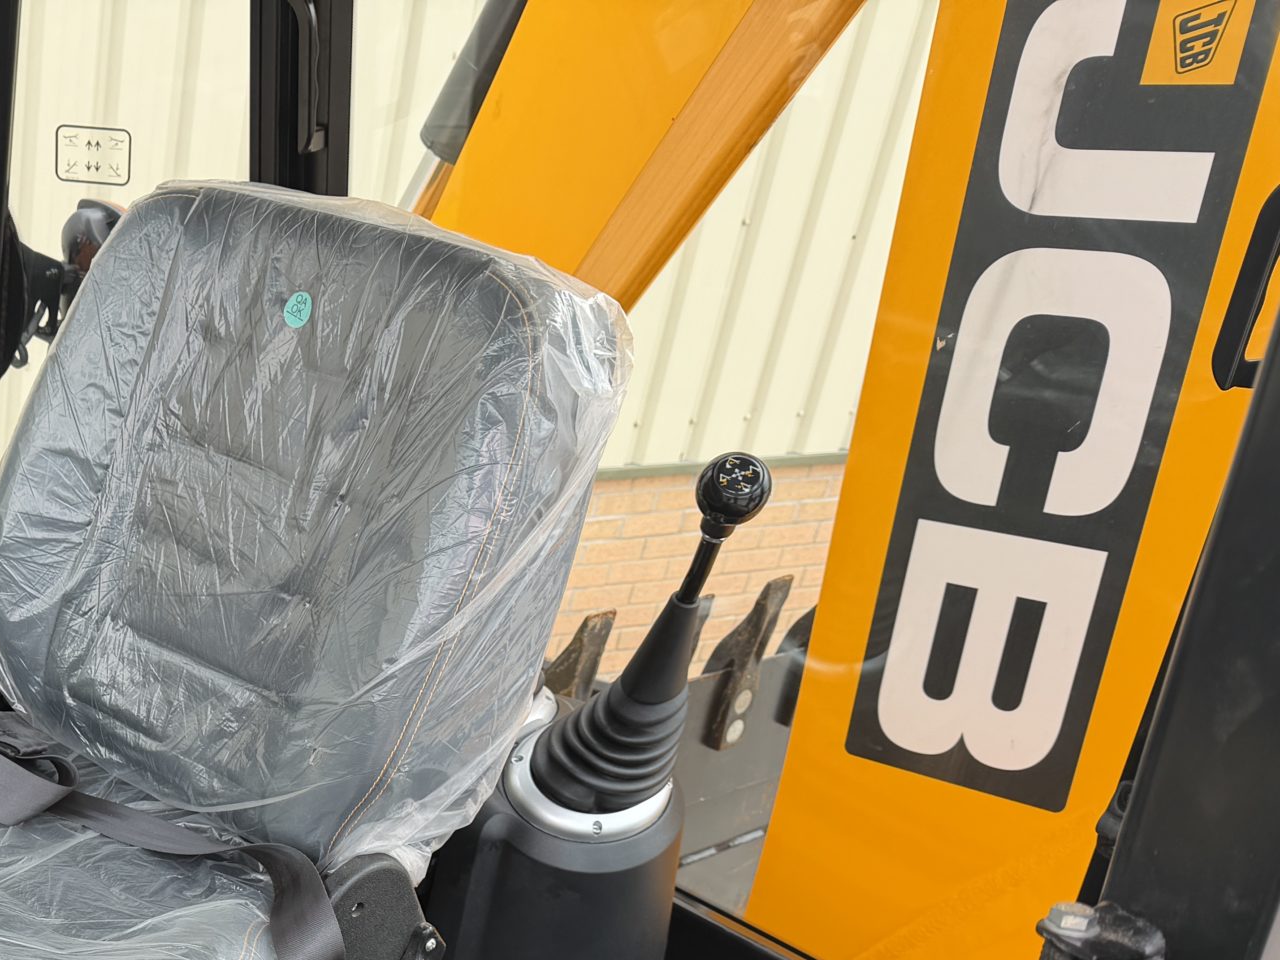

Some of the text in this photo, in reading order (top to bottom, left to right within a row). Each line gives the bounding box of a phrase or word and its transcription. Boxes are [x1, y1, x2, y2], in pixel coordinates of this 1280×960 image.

[1179, 10, 1228, 68] JCB
[291, 304, 304, 317] OK
[296, 294, 307, 308] QA
[877, 0, 1215, 772] JCB
